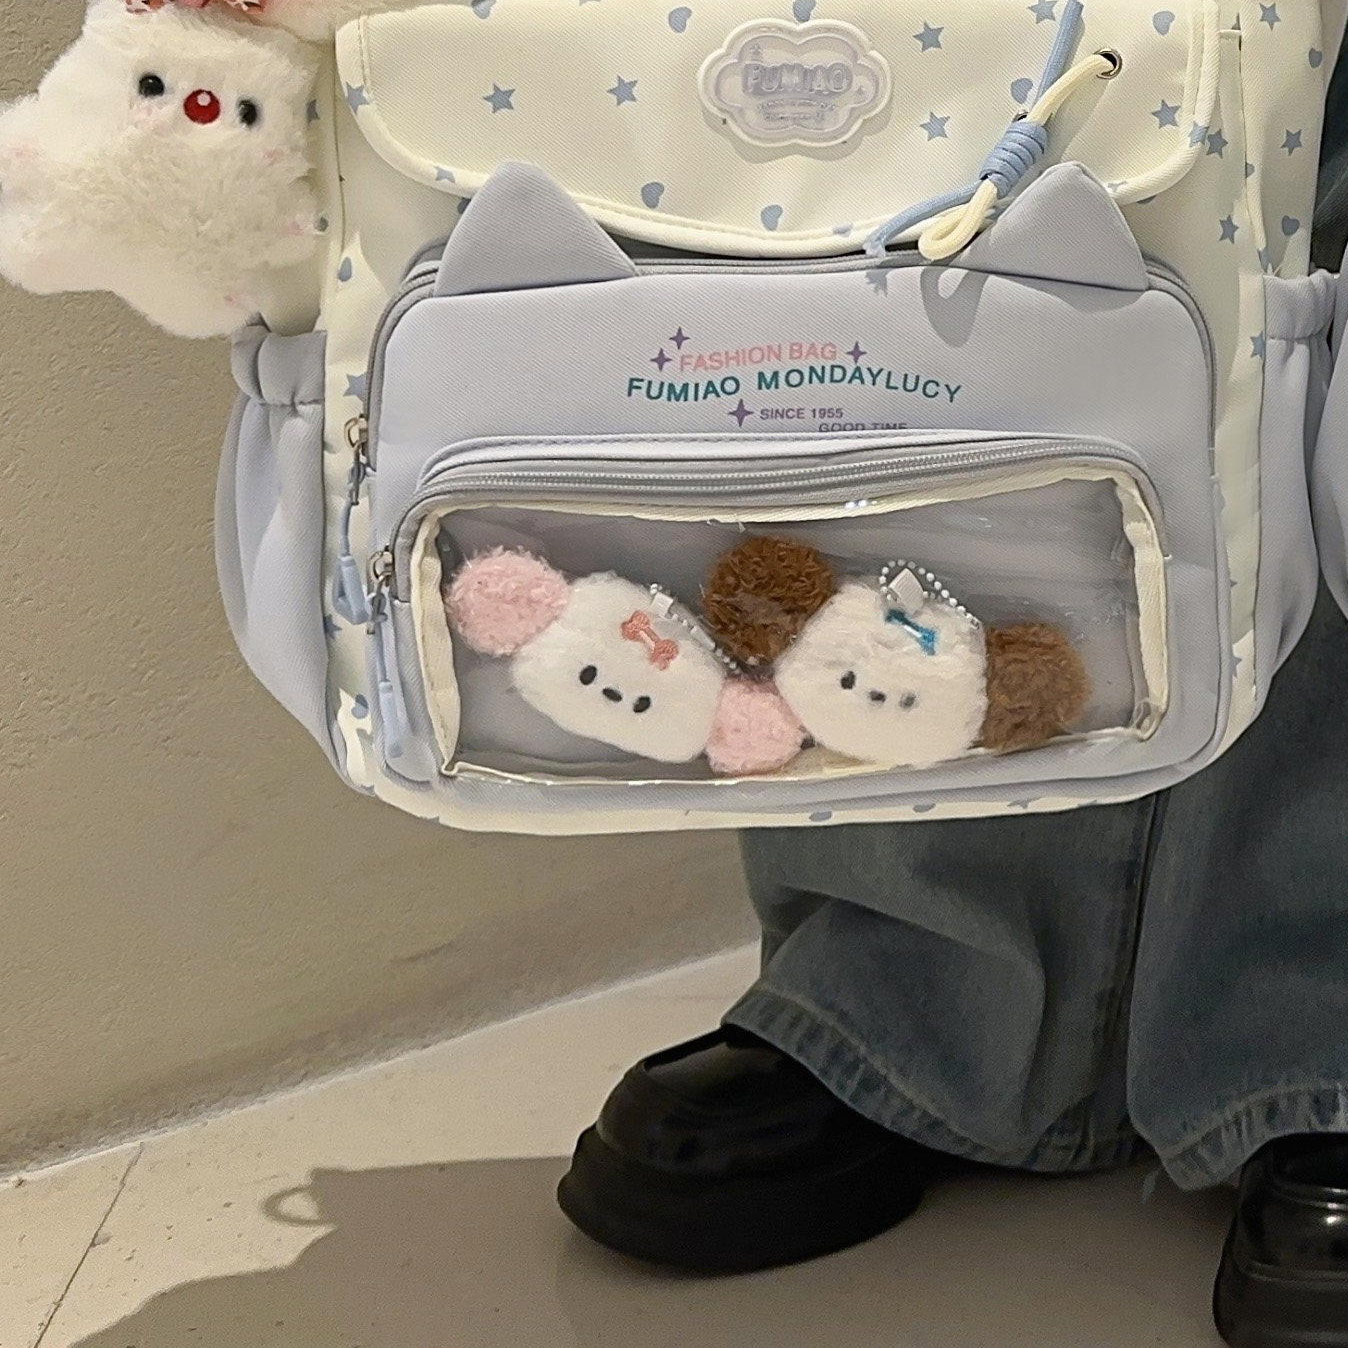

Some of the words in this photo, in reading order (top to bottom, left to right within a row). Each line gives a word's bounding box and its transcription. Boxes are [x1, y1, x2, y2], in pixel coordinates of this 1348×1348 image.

[680, 344, 782, 372] FASHION
[789, 342, 837, 361] BAG
[627, 376, 741, 402] FUMIAO
[757, 365, 962, 403] MONDAYLUCY
[760, 408, 805, 420] SINCE
[811, 407, 843, 419] 1955
